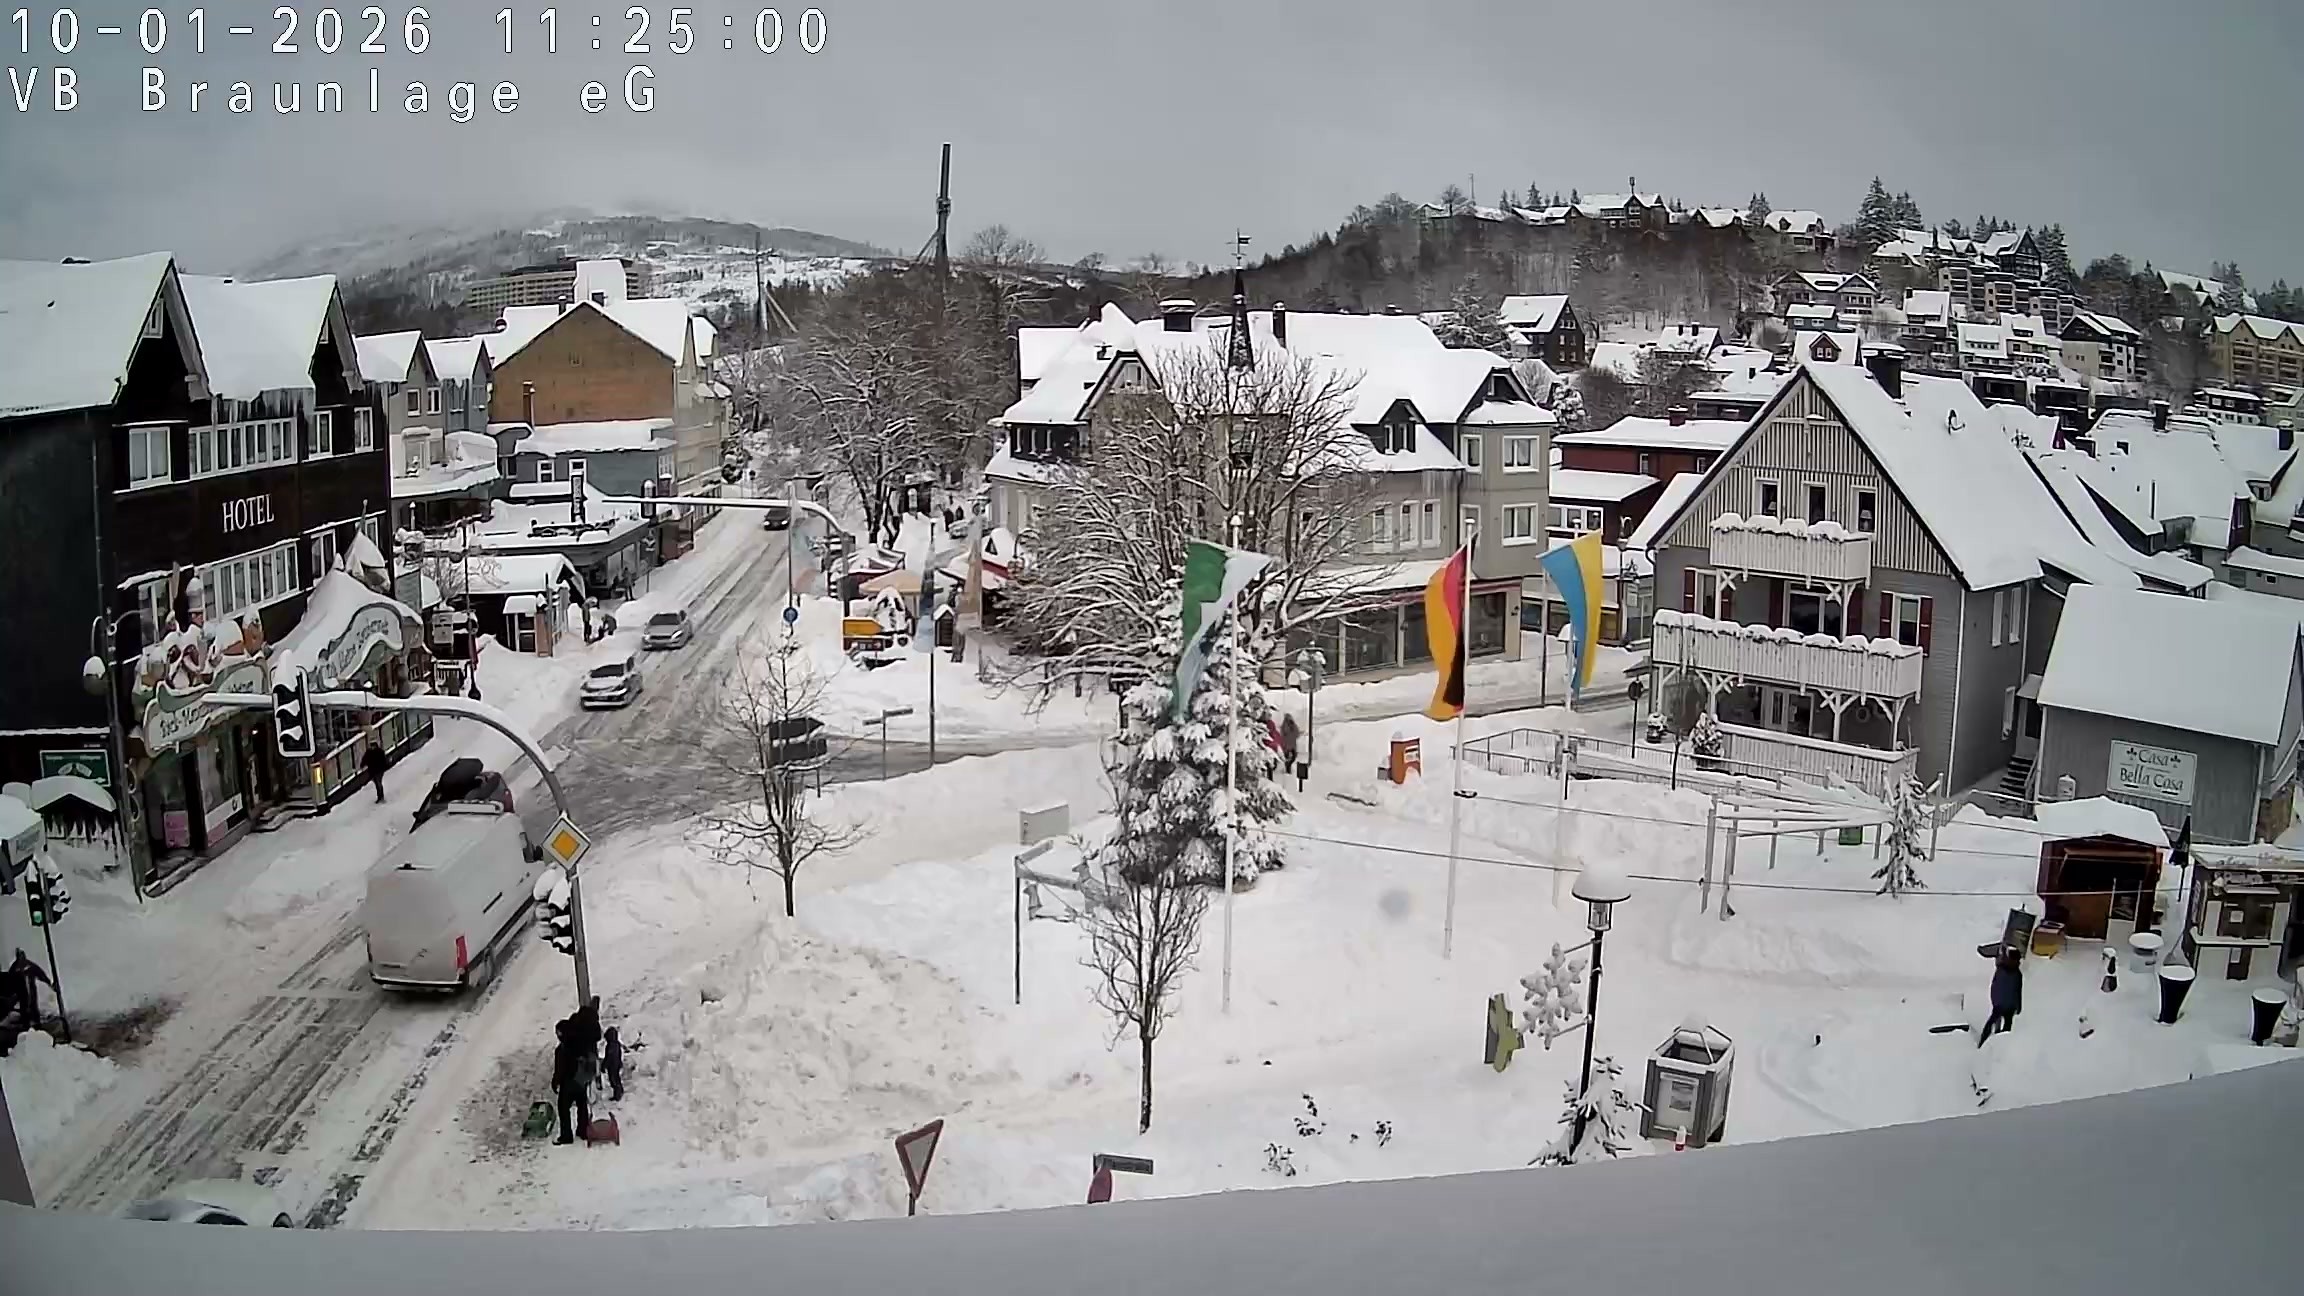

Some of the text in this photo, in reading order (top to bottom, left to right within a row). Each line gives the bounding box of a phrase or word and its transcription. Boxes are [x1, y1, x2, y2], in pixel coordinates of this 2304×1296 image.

[222, 494, 275, 533] HOTEL
[2139, 749, 2169, 766] Casa
[2120, 764, 2183, 790] Bella Casa
